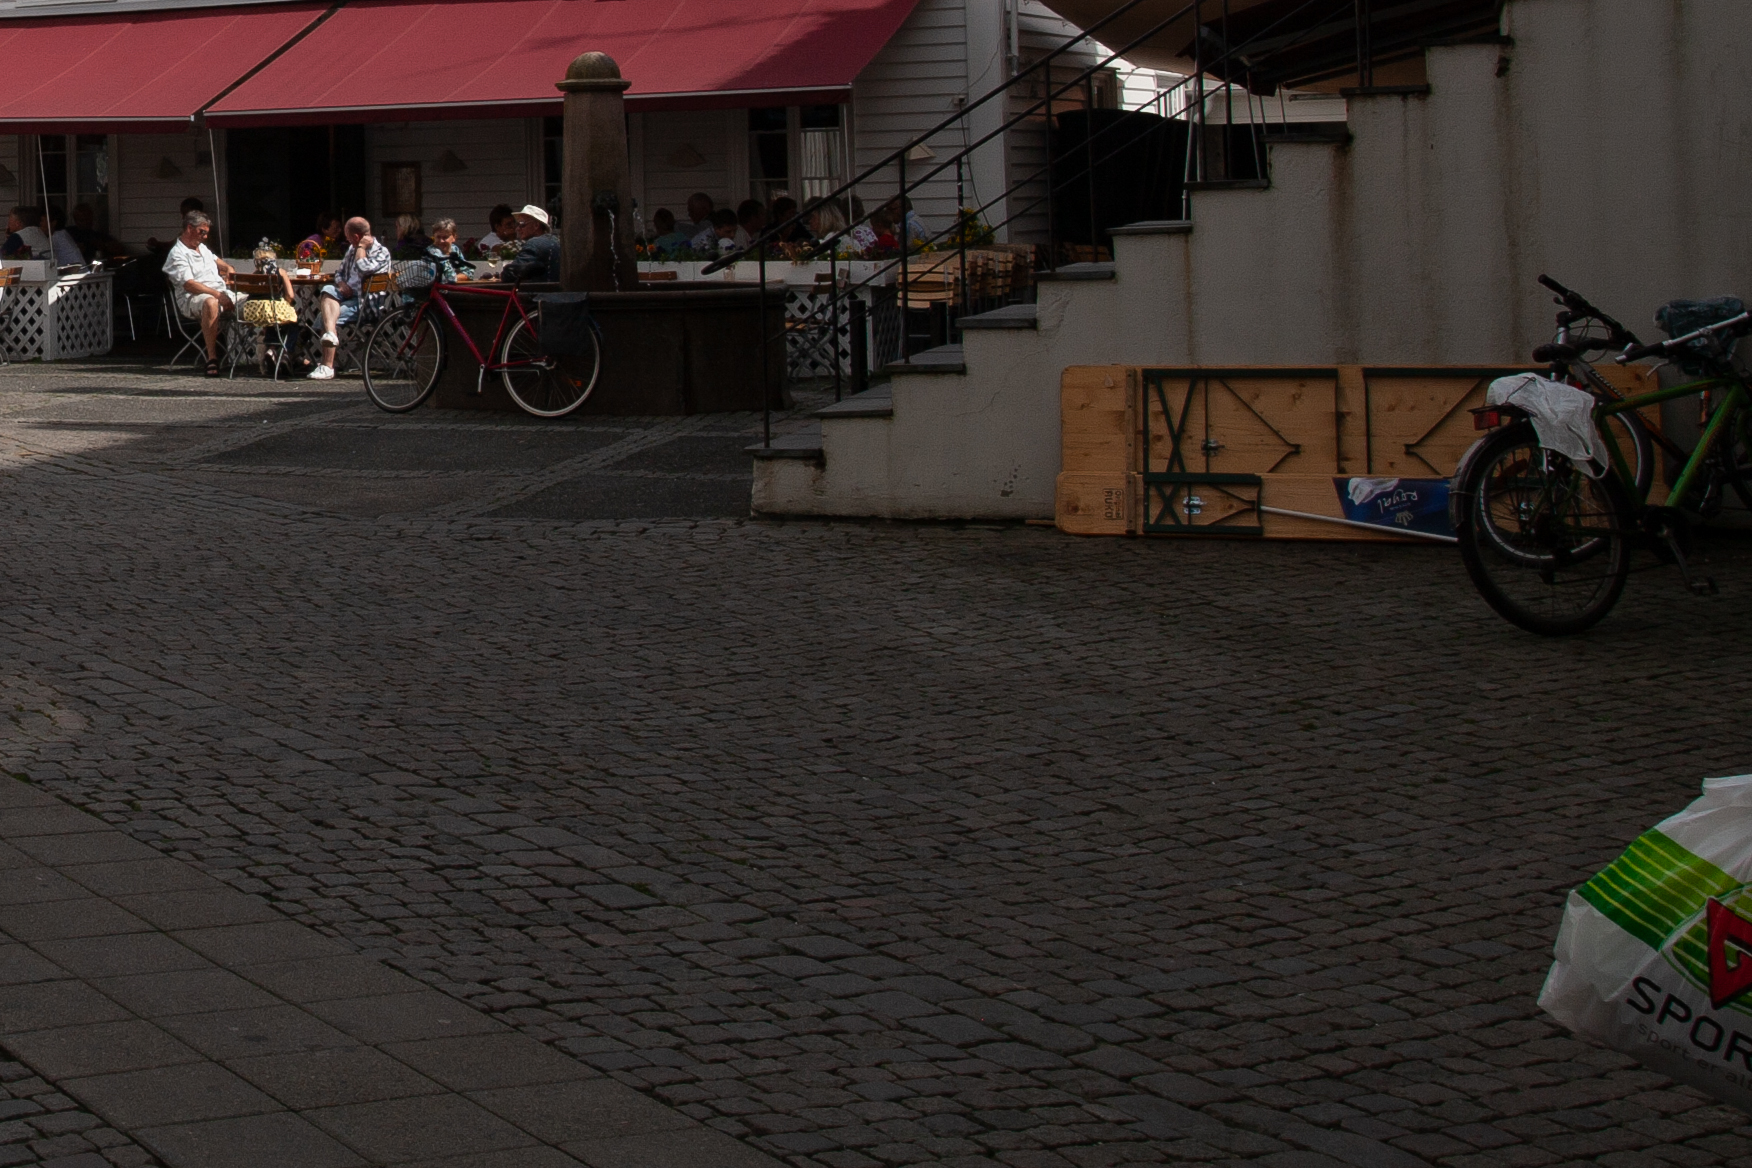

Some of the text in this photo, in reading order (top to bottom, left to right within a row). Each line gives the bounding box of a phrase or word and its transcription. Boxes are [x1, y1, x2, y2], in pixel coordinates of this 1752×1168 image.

[1377, 488, 1418, 514] Royal
[1637, 1022, 1690, 1060] sport
[1696, 1058, 1718, 1075] er
